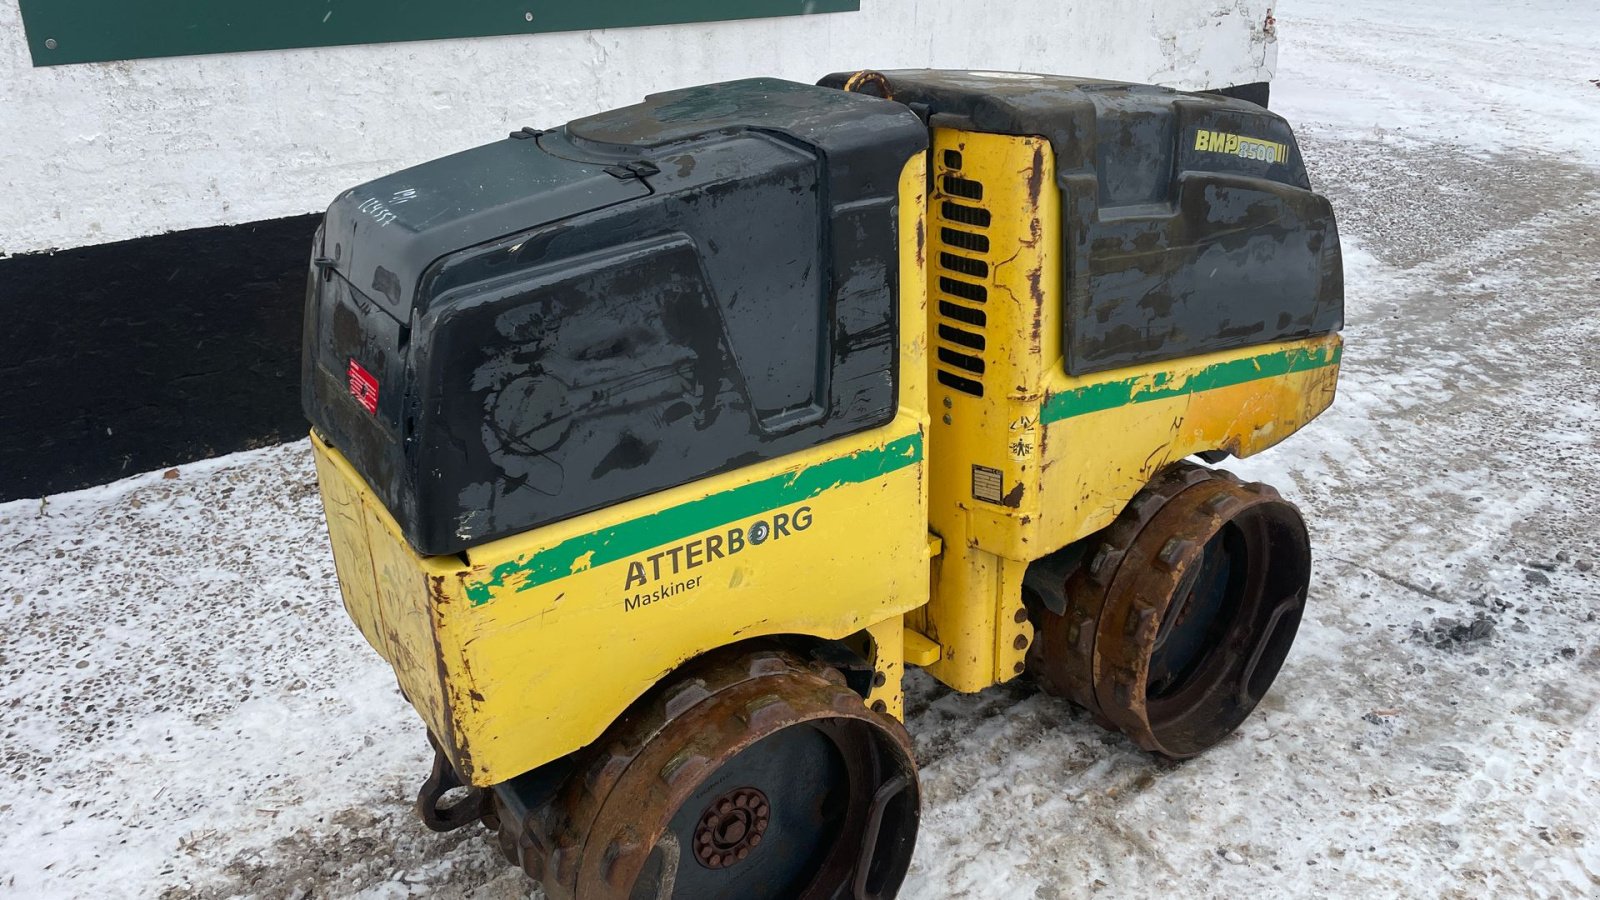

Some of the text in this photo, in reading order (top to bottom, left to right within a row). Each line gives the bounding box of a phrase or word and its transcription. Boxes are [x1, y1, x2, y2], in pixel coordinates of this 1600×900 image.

[1195, 129, 1276, 164] BMP 8500
[624, 506, 813, 591] ATTERBORG
[624, 575, 703, 612] Maskiner
